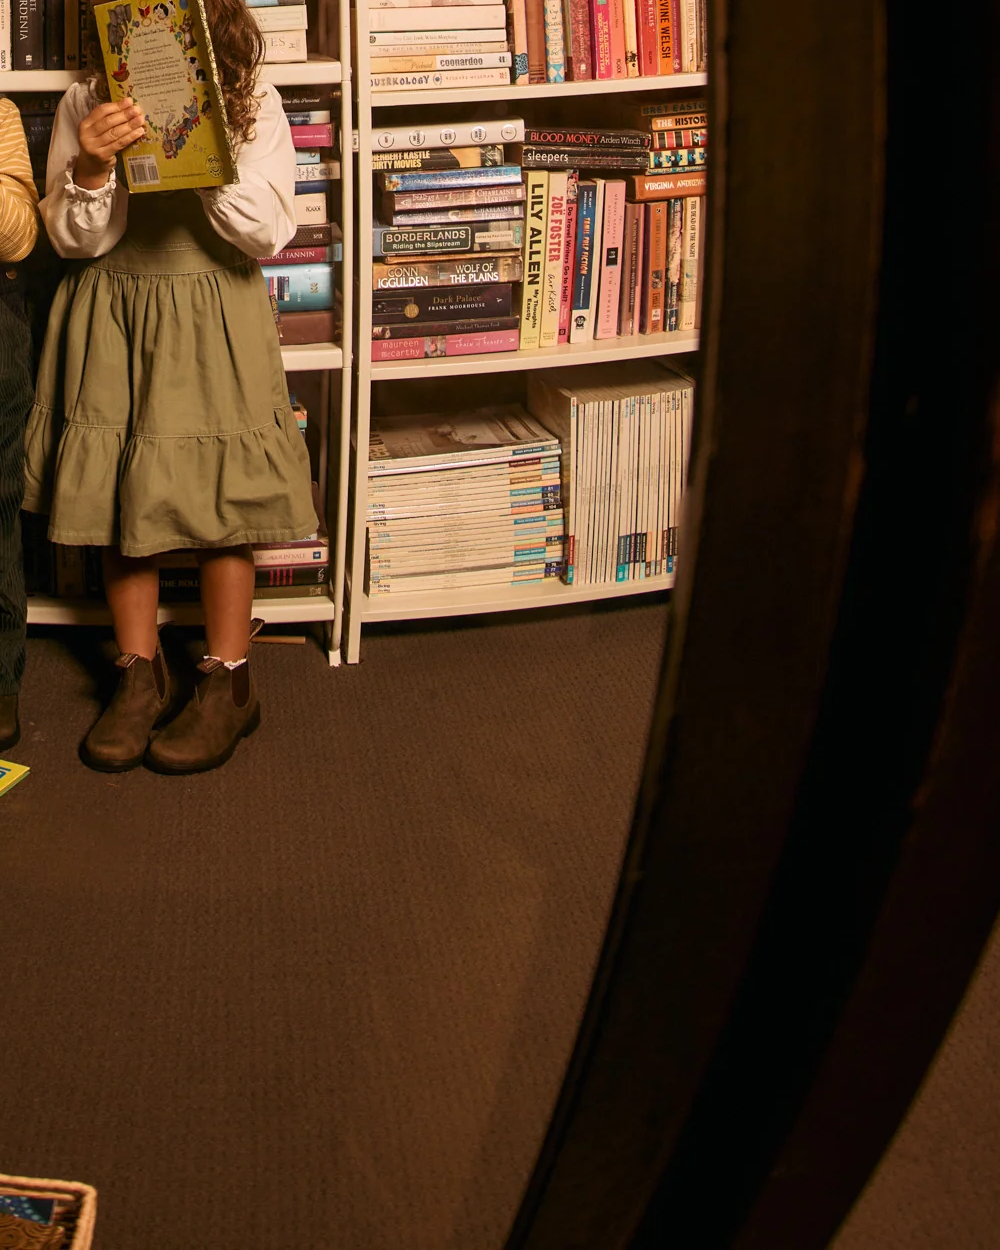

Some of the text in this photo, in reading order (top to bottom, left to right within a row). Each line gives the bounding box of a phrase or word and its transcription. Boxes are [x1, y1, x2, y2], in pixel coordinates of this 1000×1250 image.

[660, 25, 671, 59] WELSH
[439, 56, 484, 67] coonardoo
[530, 131, 565, 143] BLOOD
[566, 133, 601, 144] MONEY
[600, 136, 620, 144] Arden
[620, 137, 642, 145] Winch
[527, 151, 570, 163] sleepers
[385, 230, 467, 243] BORDERLANDS
[527, 183, 544, 286] LILY ALLEN
[392, 240, 461, 250] Riding the Slipstream
[548, 220, 563, 263] FOSTER
[388, 266, 418, 278] CONN
[455, 263, 494, 275] WOLF OF
[378, 275, 429, 289] IGGULDEN
[450, 272, 500, 284] THE PLAINS
